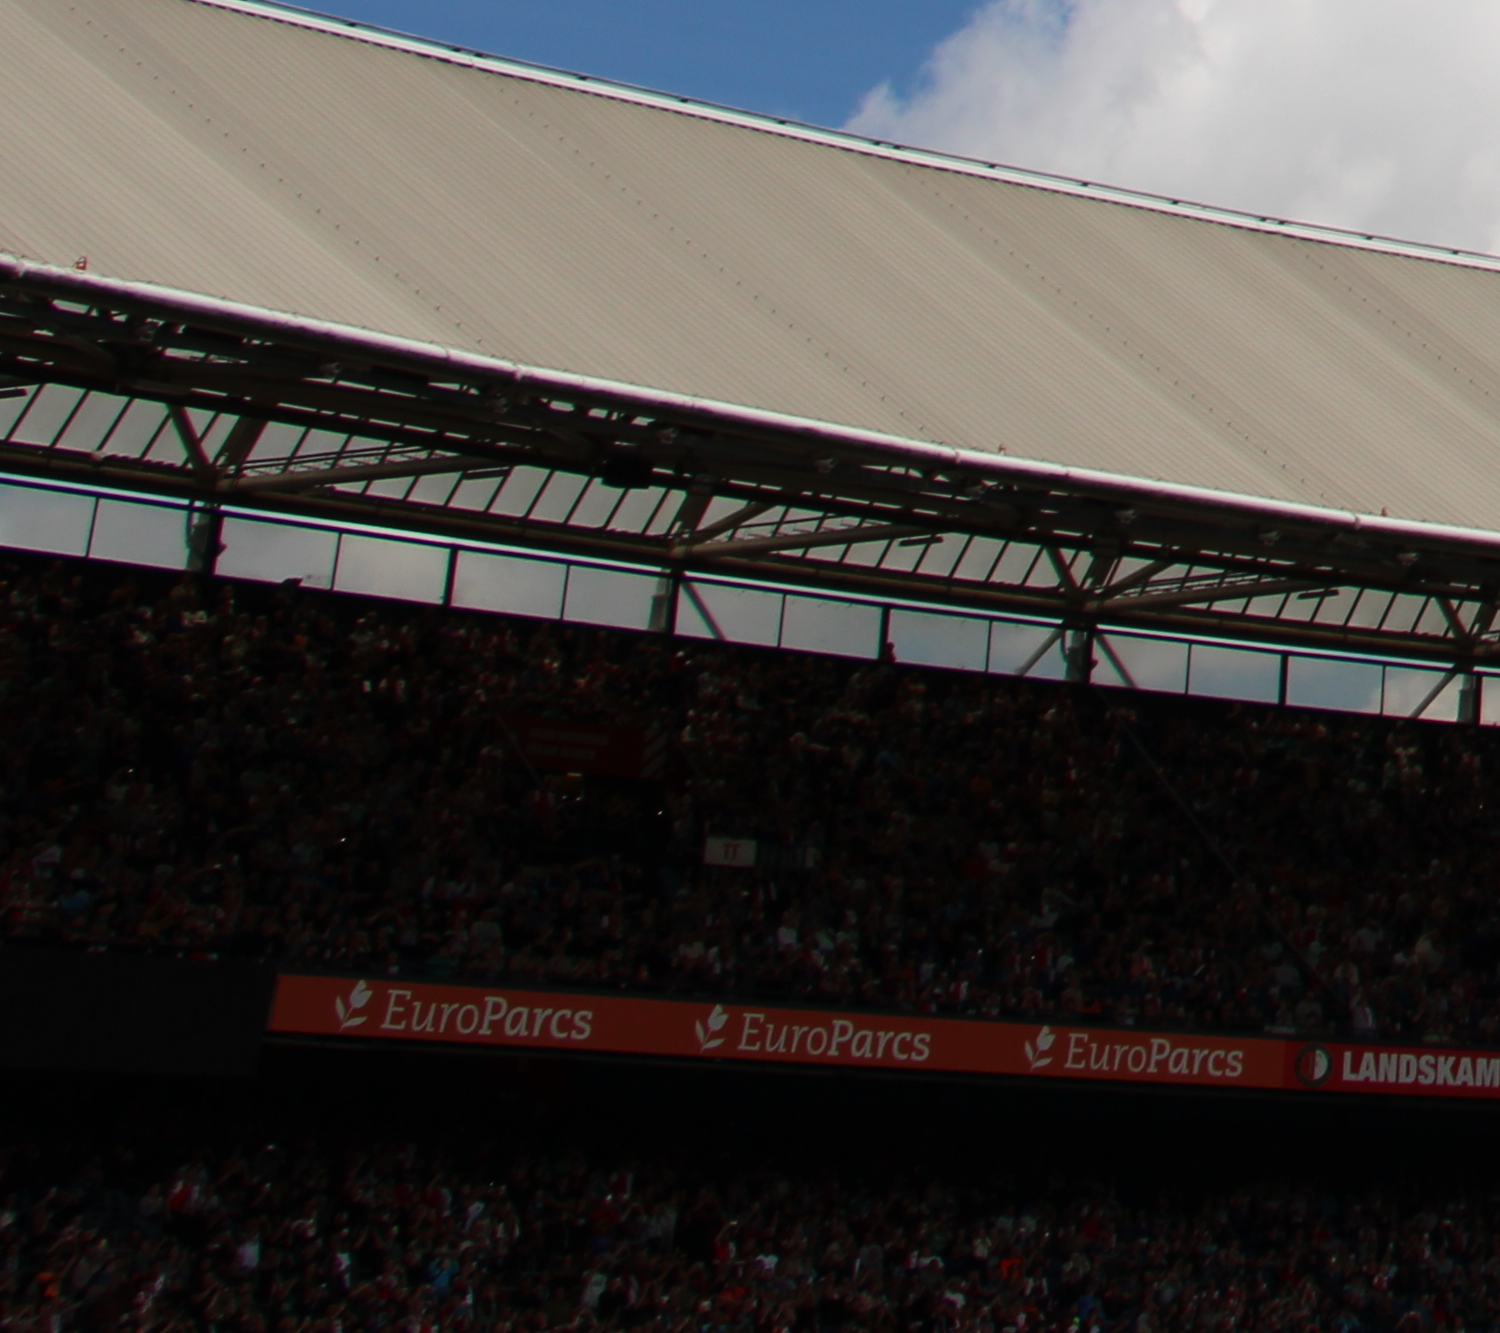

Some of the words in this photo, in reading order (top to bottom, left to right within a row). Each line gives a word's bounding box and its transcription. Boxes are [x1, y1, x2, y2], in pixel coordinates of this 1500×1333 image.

[380, 989, 594, 1040] EuroParcs
[737, 1012, 931, 1062] EuroParcs
[1064, 1032, 1244, 1078] EuroParcs
